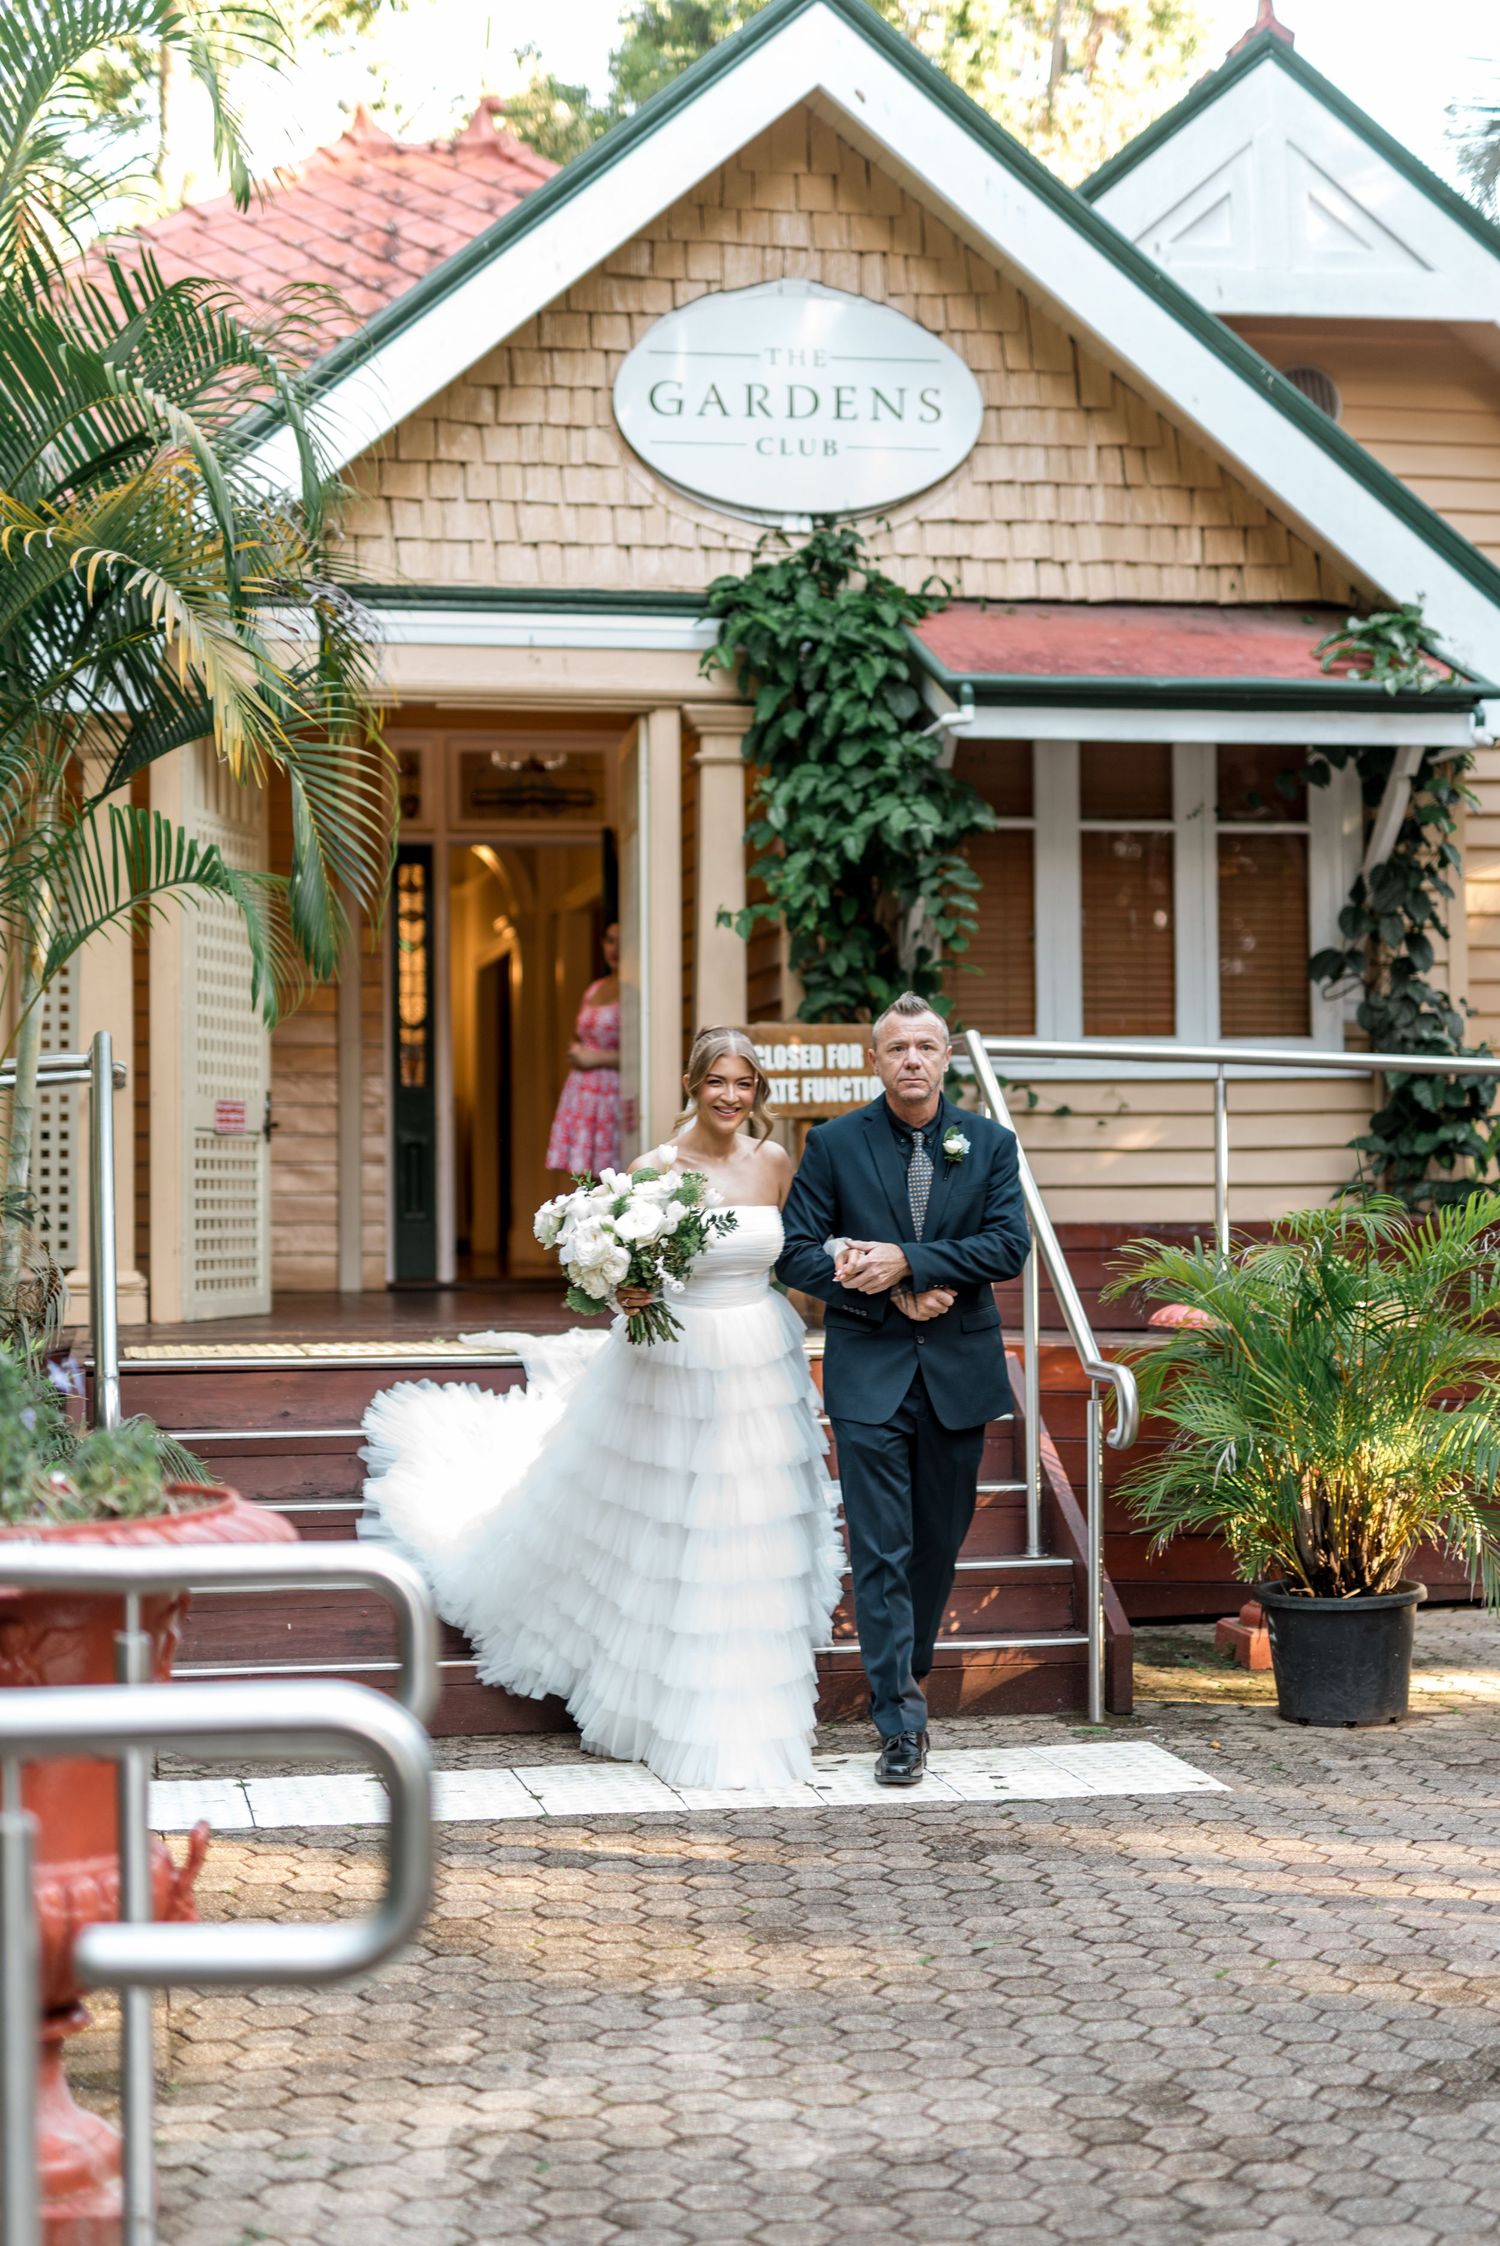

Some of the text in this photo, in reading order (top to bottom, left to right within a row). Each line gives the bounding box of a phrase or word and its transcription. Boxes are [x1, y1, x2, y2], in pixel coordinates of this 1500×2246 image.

[764, 347, 828, 368] THE
[648, 380, 943, 423] GARDENS
[755, 436, 839, 457] CLUB
[753, 1043, 864, 1070] CLOSED FOR
[767, 1075, 886, 1104] ATE FUNCTIO
